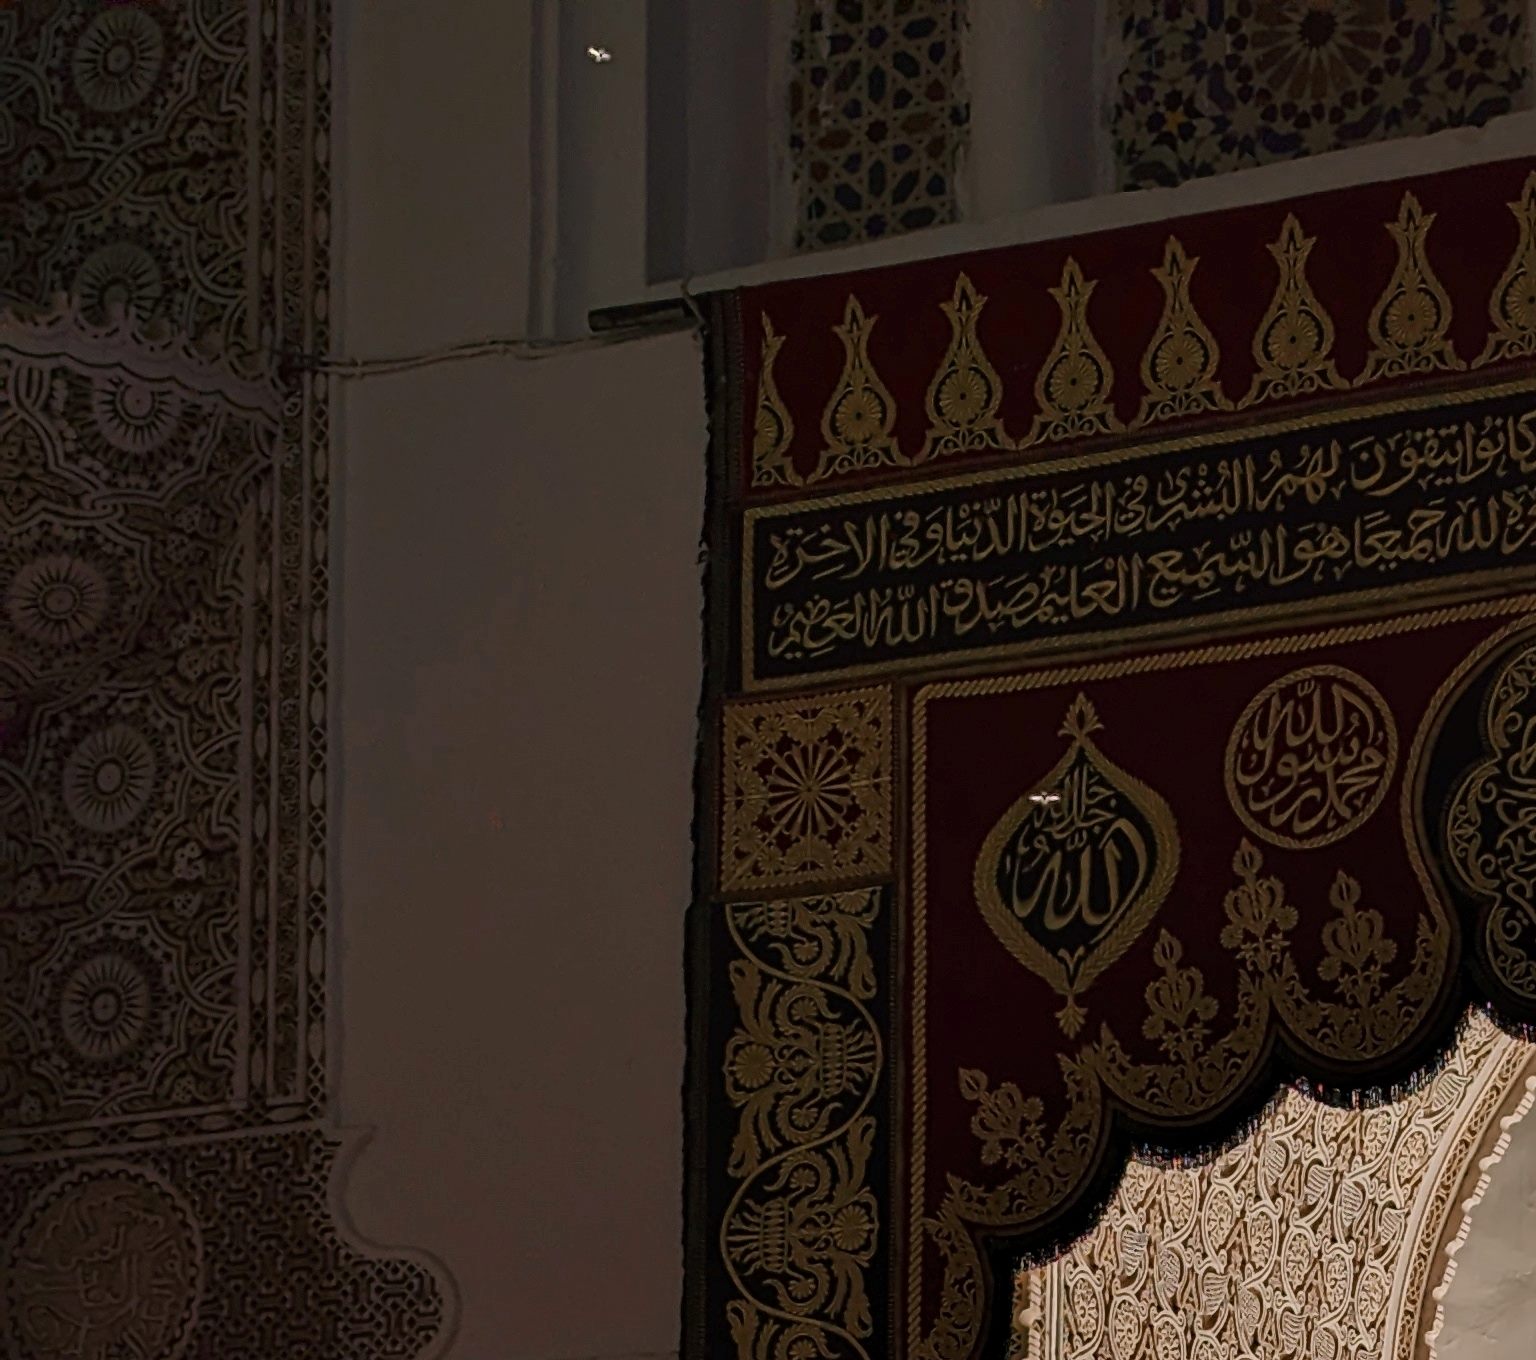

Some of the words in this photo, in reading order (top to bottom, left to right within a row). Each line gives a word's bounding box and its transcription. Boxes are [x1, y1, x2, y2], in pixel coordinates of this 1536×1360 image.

[1256, 440, 1342, 512] لهم
[1350, 425, 1464, 497] يتقون
[946, 494, 1028, 563] الدنيا
[1268, 525, 1350, 587] هو
[1436, 495, 1500, 559] لله
[1012, 552, 1143, 628] العليم
[1148, 524, 1288, 609] السميع
[768, 588, 881, 660] العظيم
[863, 585, 940, 648] الله
[1013, 818, 1147, 945] الله
